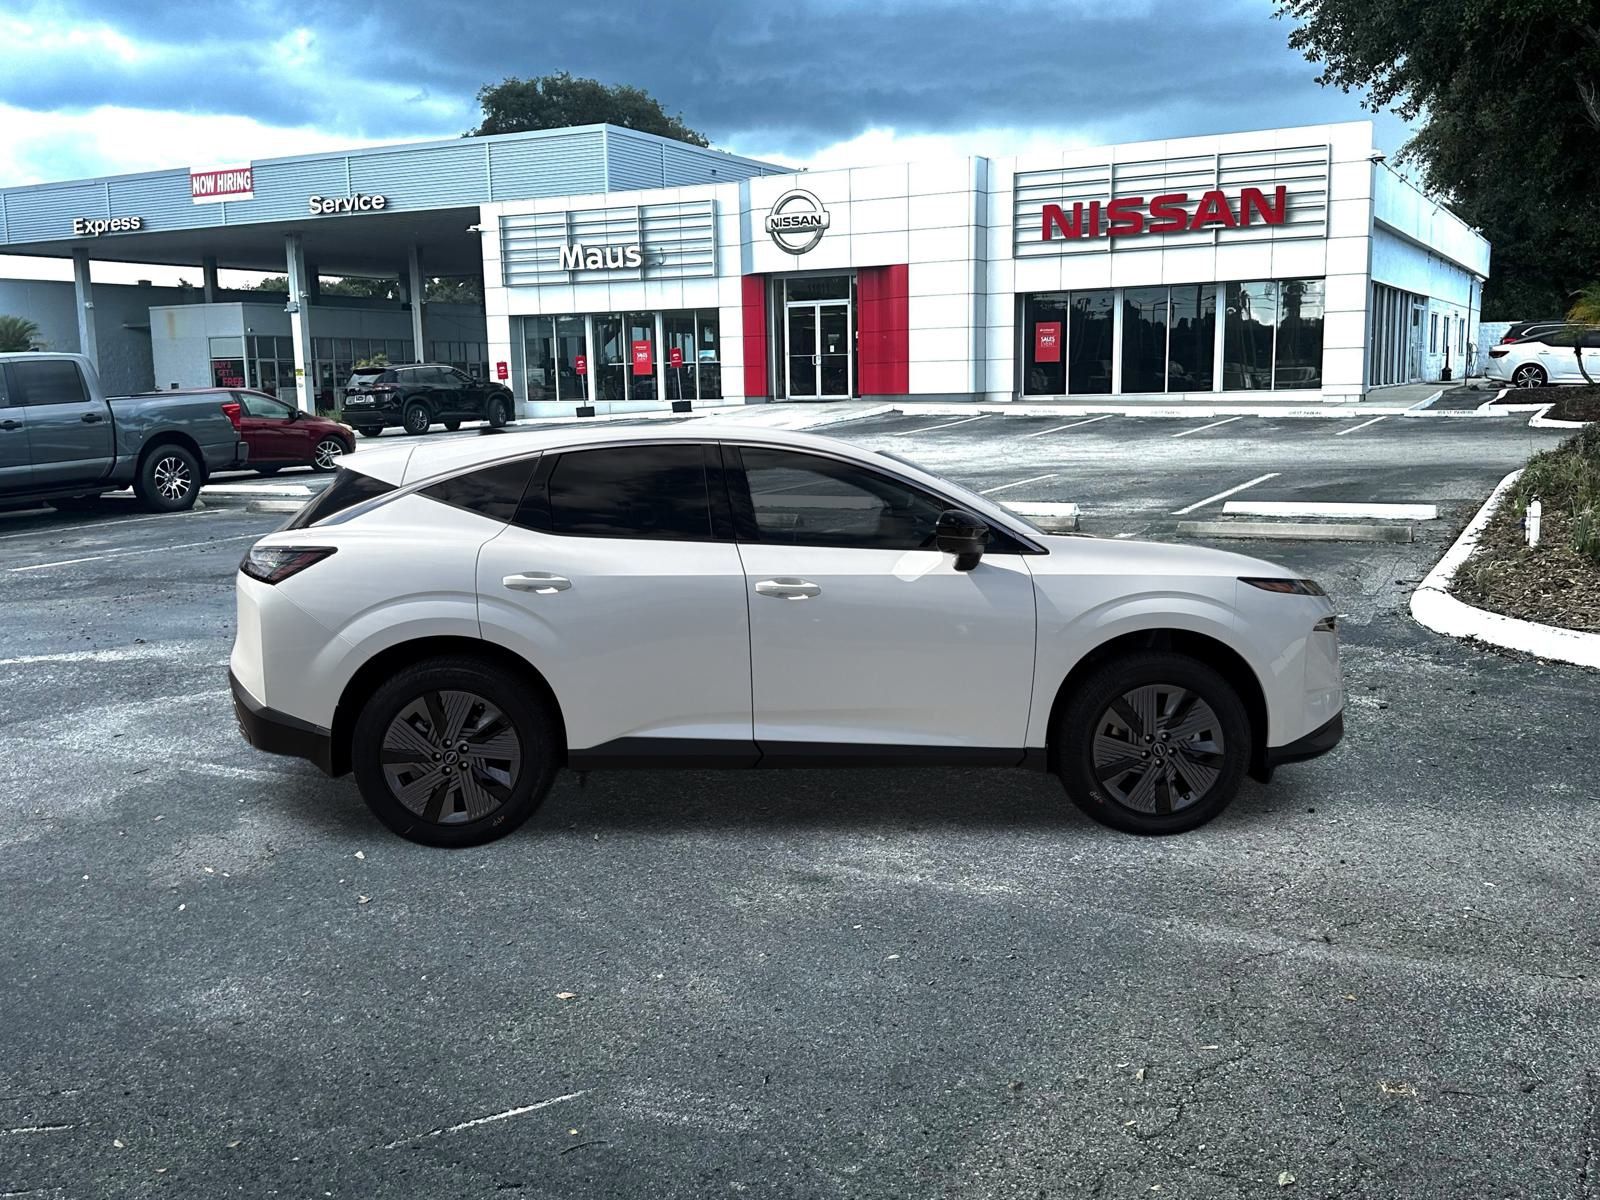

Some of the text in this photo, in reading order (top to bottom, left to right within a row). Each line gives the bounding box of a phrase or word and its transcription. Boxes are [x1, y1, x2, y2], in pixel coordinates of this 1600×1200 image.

[192, 171, 251, 195] NOW HIRING
[309, 193, 385, 215] Service
[1042, 185, 1287, 241] NISSAN
[73, 216, 141, 237] Express
[770, 214, 822, 228] NISSAN
[559, 243, 642, 270] Maus
[223, 377, 244, 386] FREE
